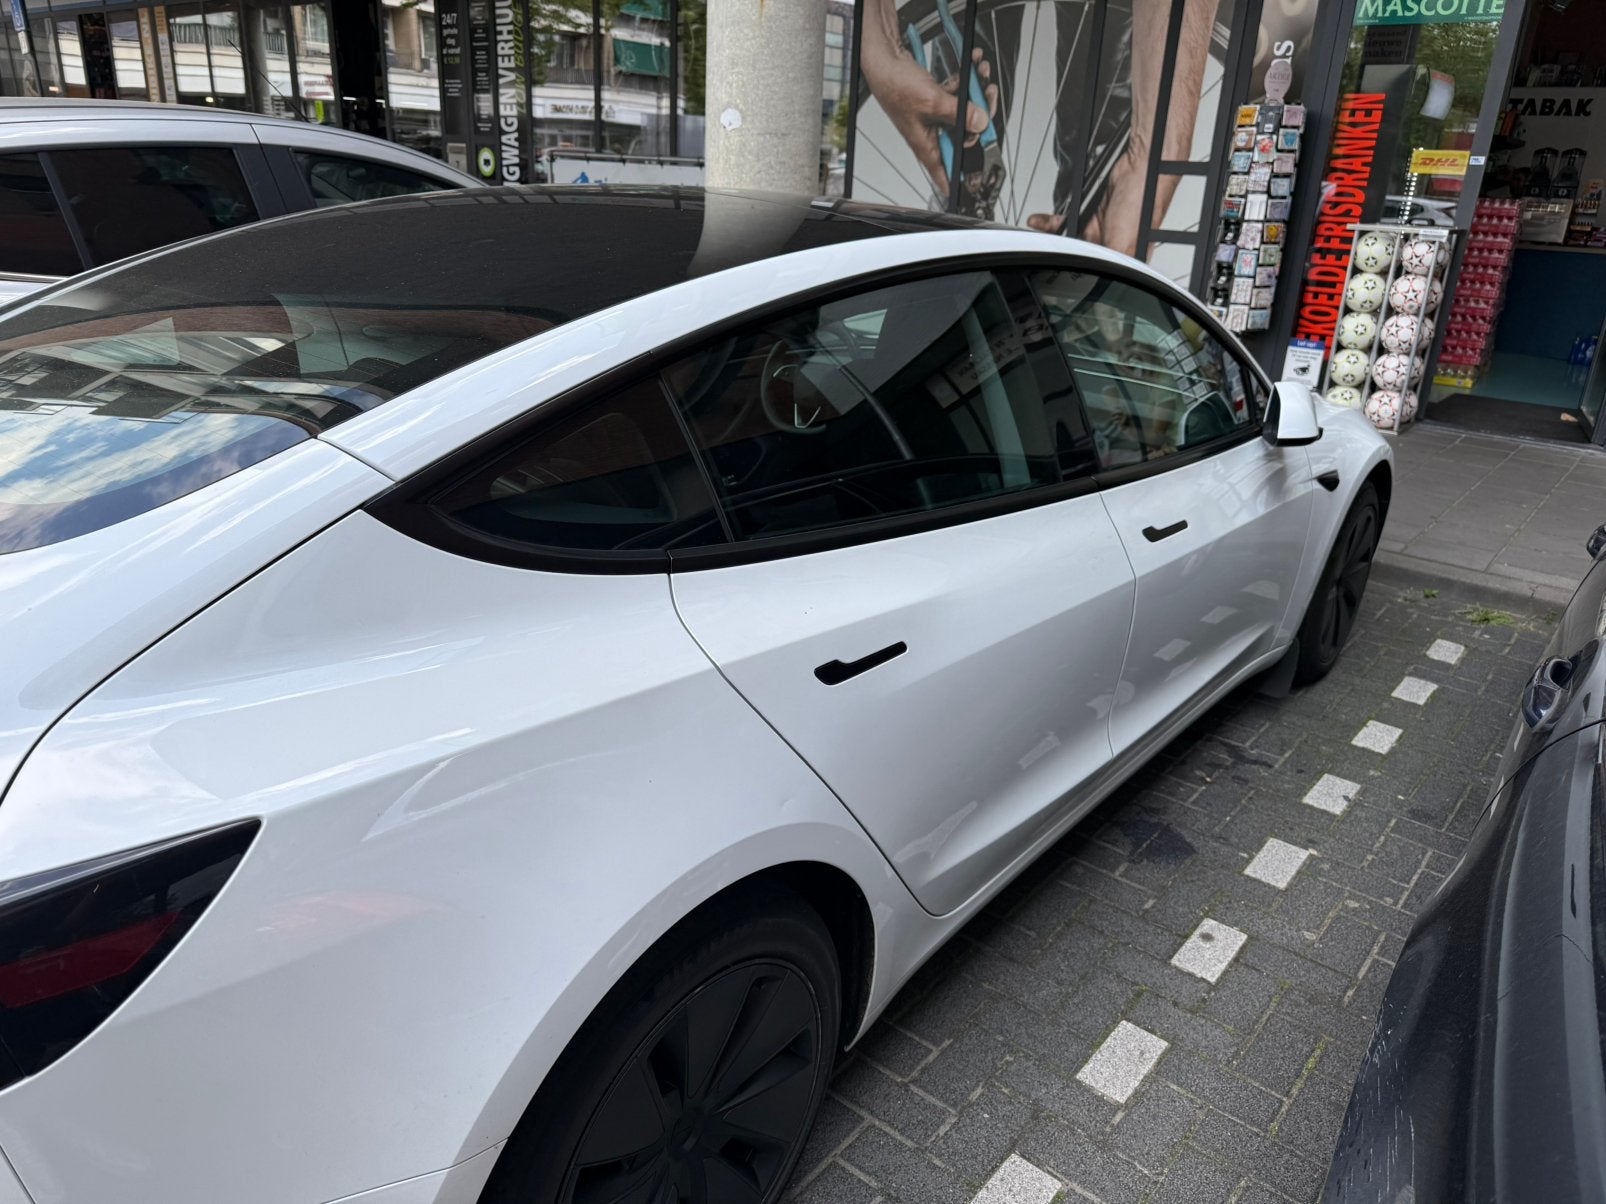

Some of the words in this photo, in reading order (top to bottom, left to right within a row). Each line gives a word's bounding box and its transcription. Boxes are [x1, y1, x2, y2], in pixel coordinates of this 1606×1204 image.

[441, 13, 458, 25] 24/7
[1508, 97, 1593, 117] TABAK
[499, 88, 520, 186] GWAGEN
[1313, 93, 1386, 251] FRISDRANKEN
[1419, 157, 1459, 167] DHL
